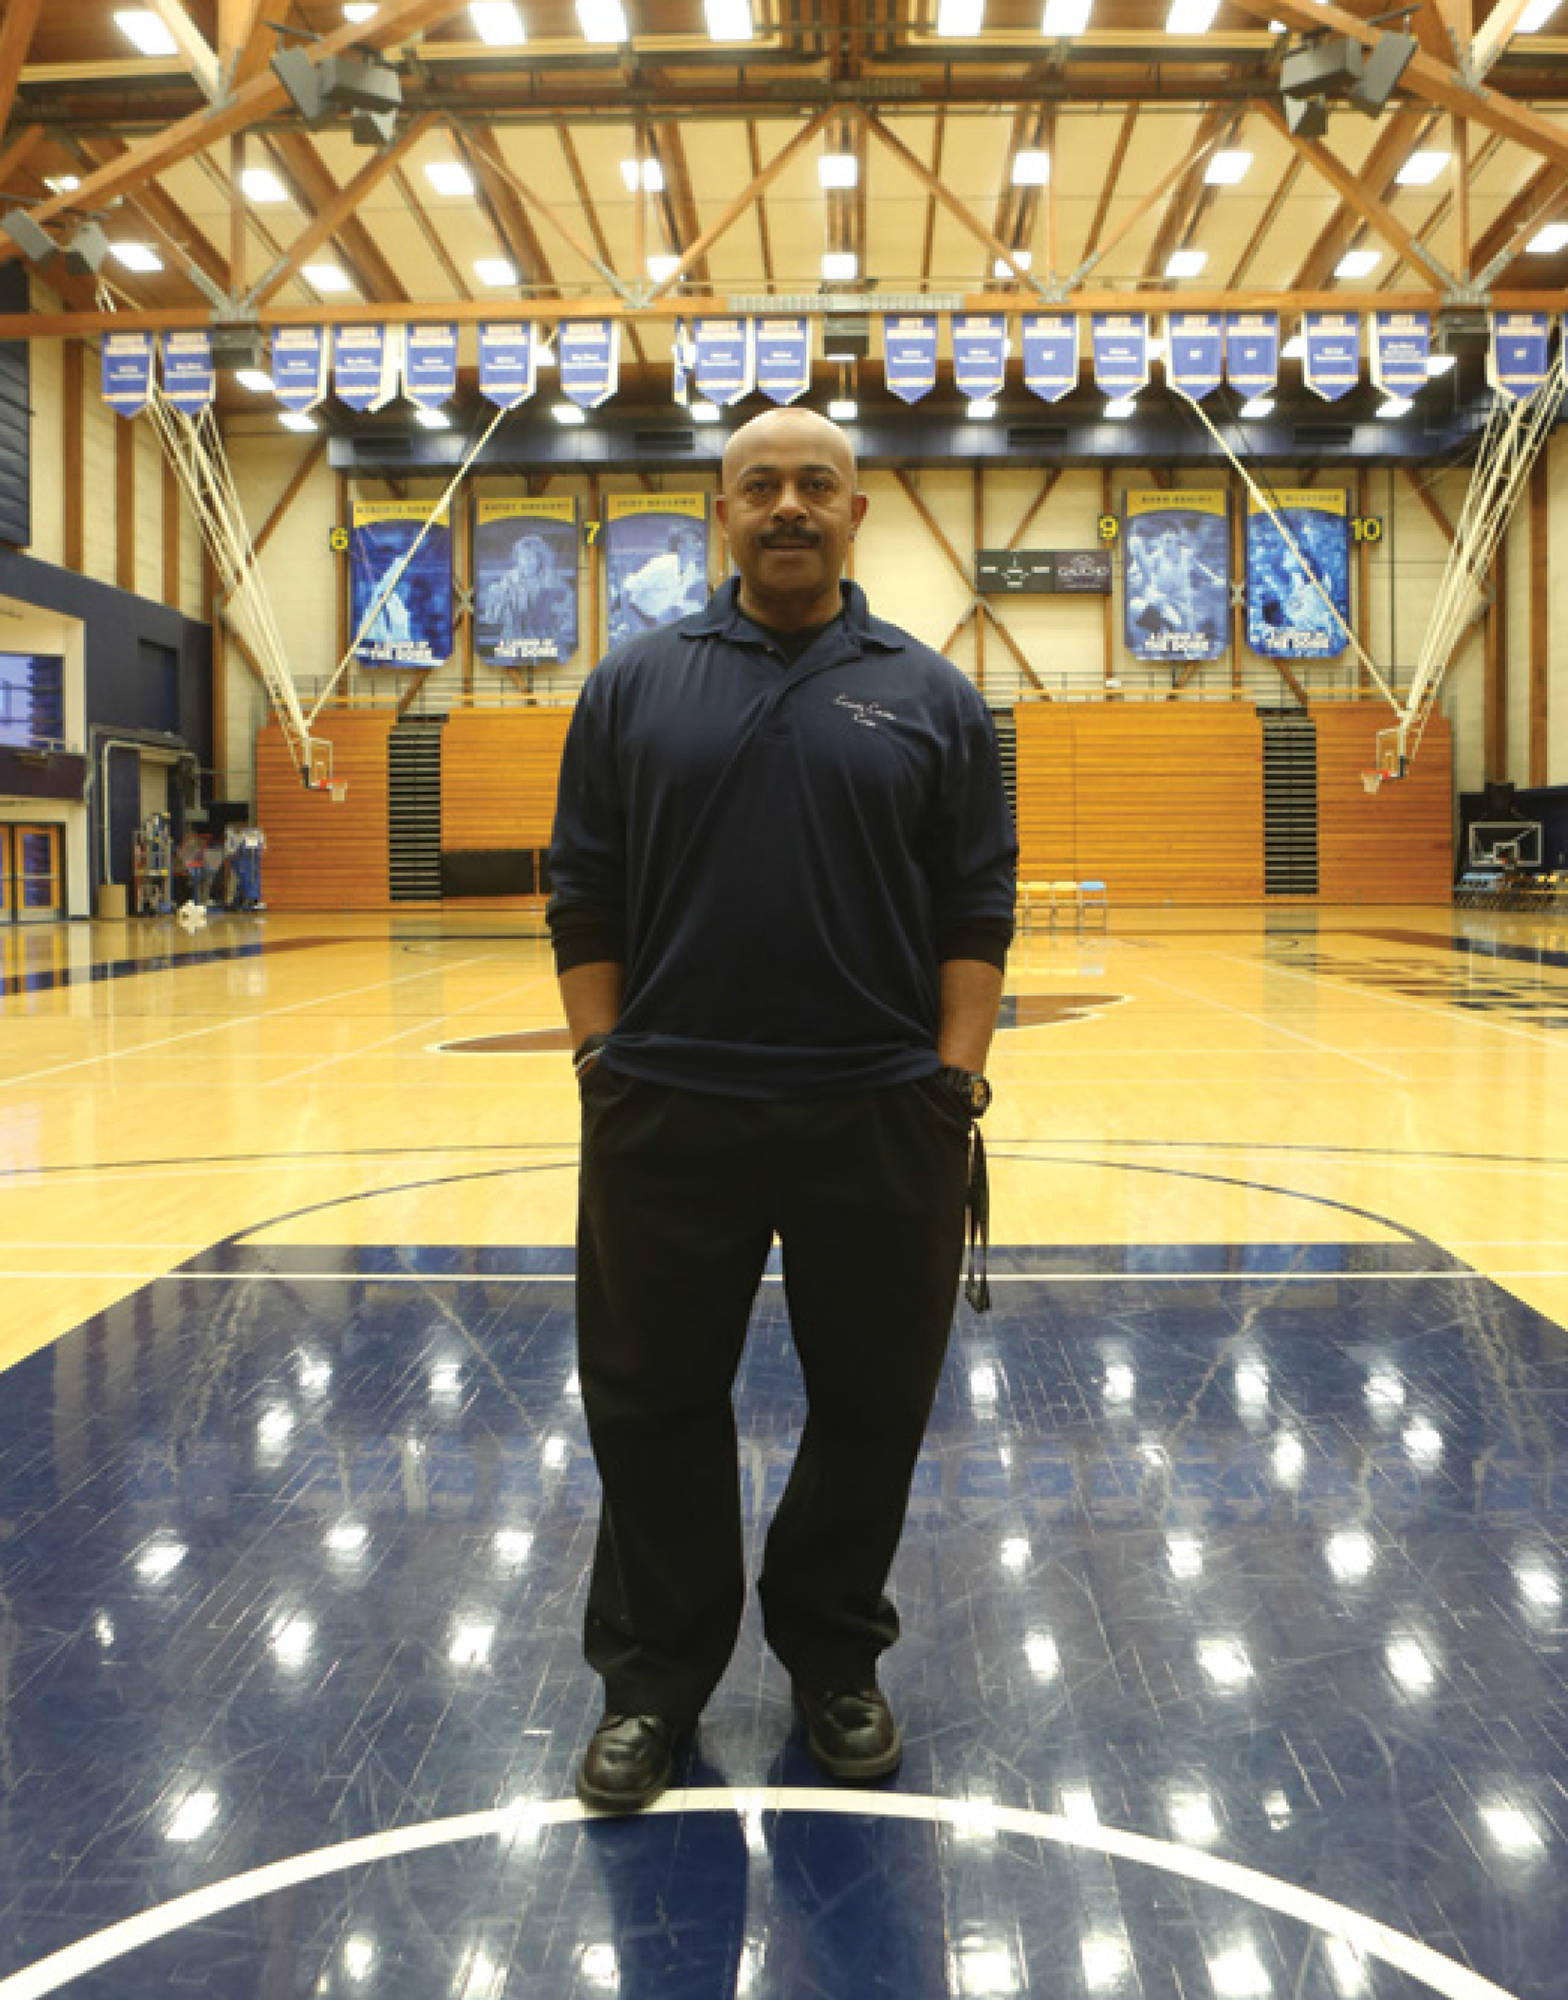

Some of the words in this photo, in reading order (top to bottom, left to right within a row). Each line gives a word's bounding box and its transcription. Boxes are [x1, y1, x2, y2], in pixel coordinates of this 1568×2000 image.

[585, 521, 600, 543] 7
[1100, 516, 1117, 539] 9
[1351, 520, 1380, 541] 10
[332, 528, 348, 549] 6
